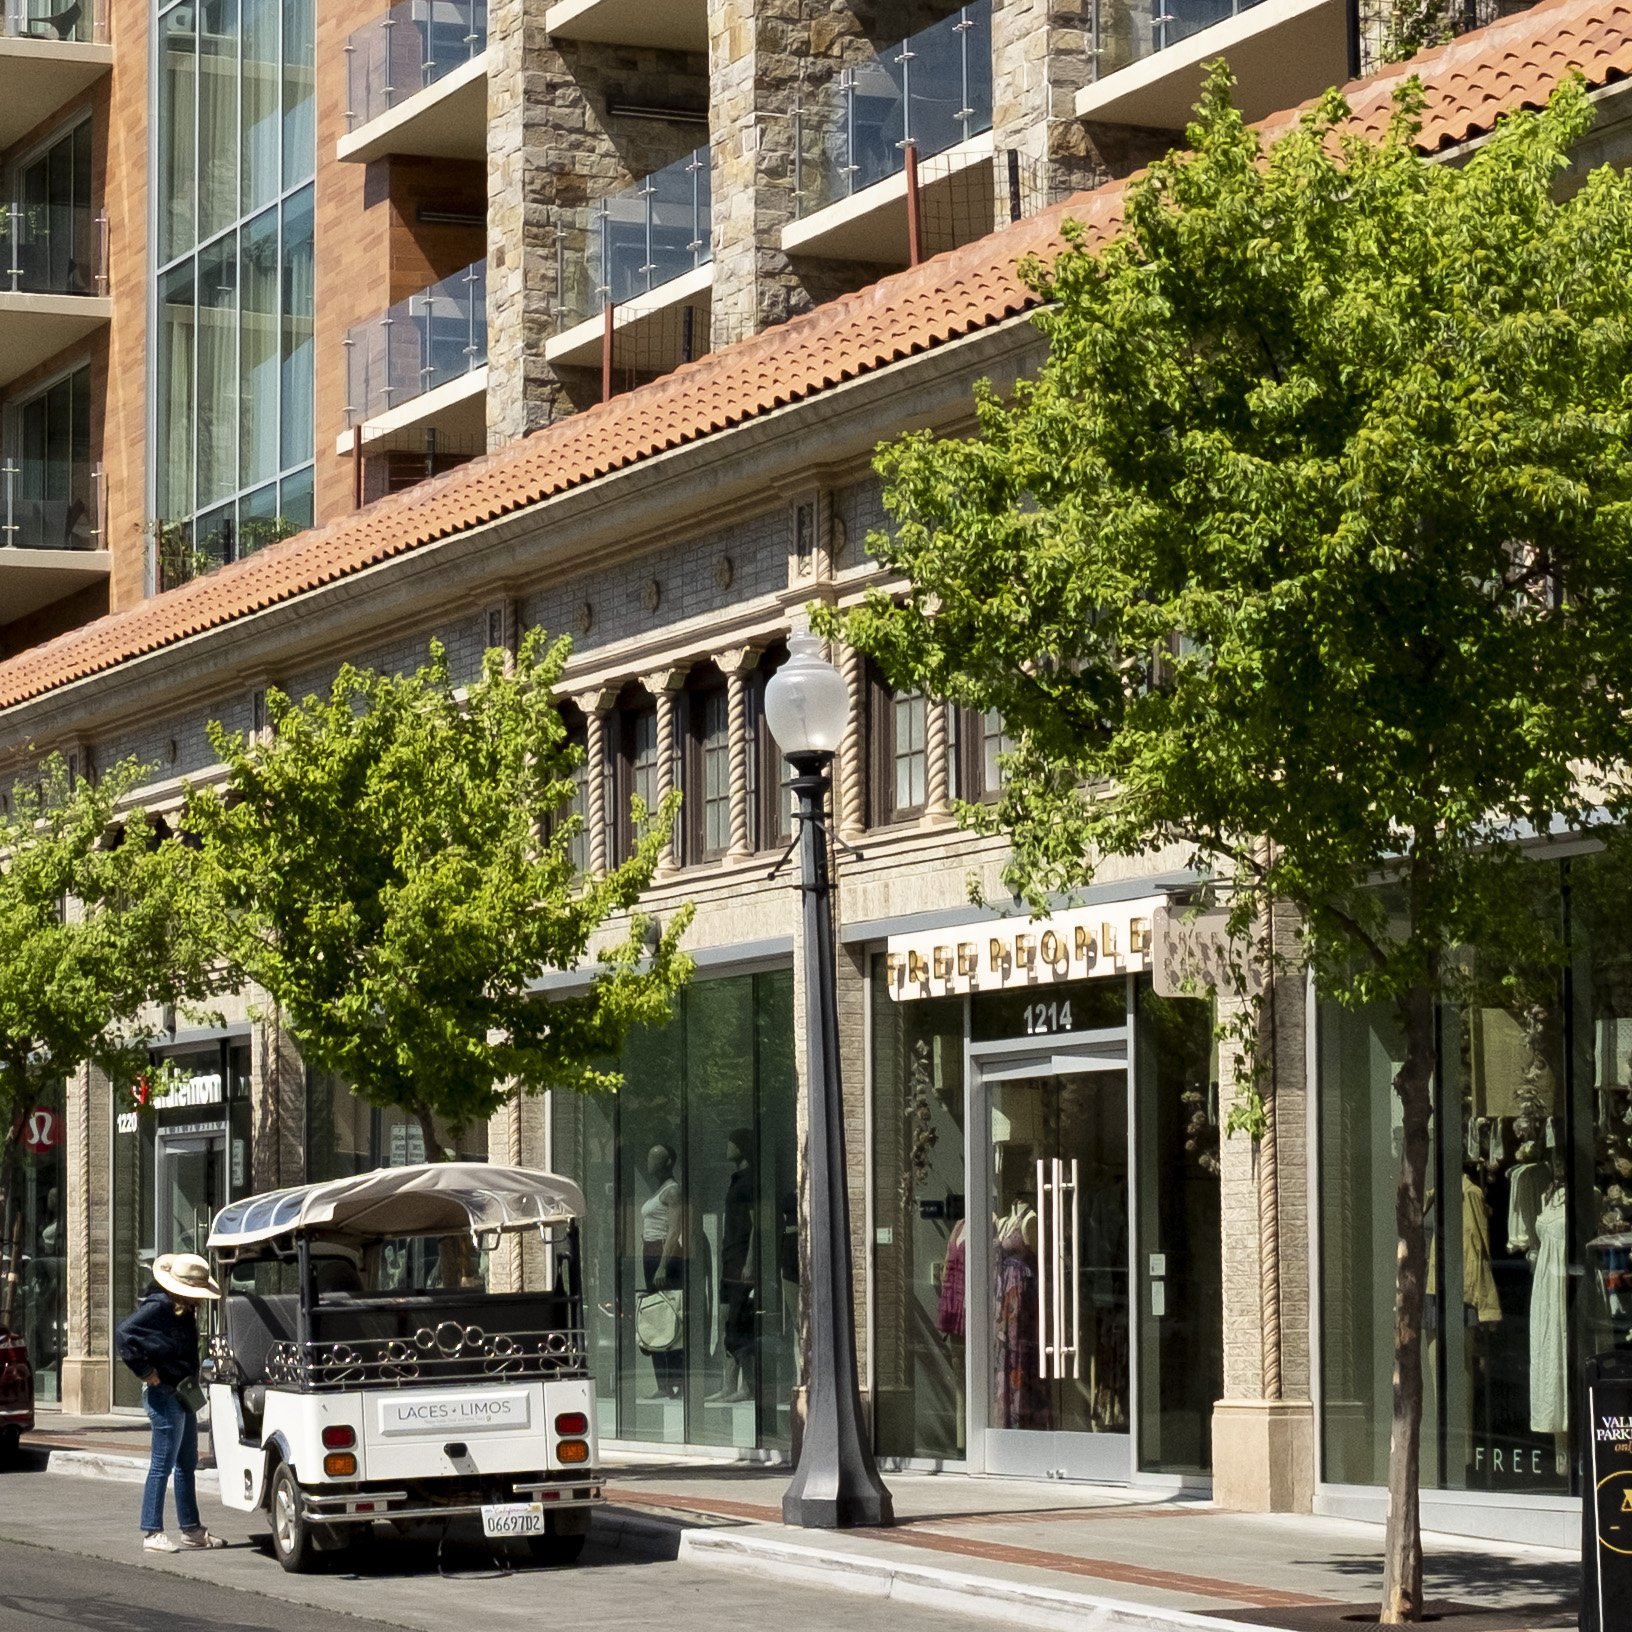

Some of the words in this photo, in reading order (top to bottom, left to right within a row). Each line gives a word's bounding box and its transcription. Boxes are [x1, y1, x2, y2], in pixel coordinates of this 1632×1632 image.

[886, 941, 979, 986] FREE
[989, 917, 1153, 973] PEOPLE
[1023, 999, 1072, 1035] 1214
[116, 1112, 138, 1134] 1220
[397, 1404, 448, 1420] LACES
[461, 1400, 511, 1416] LIMOS
[1475, 1447, 1543, 1474] FREE
